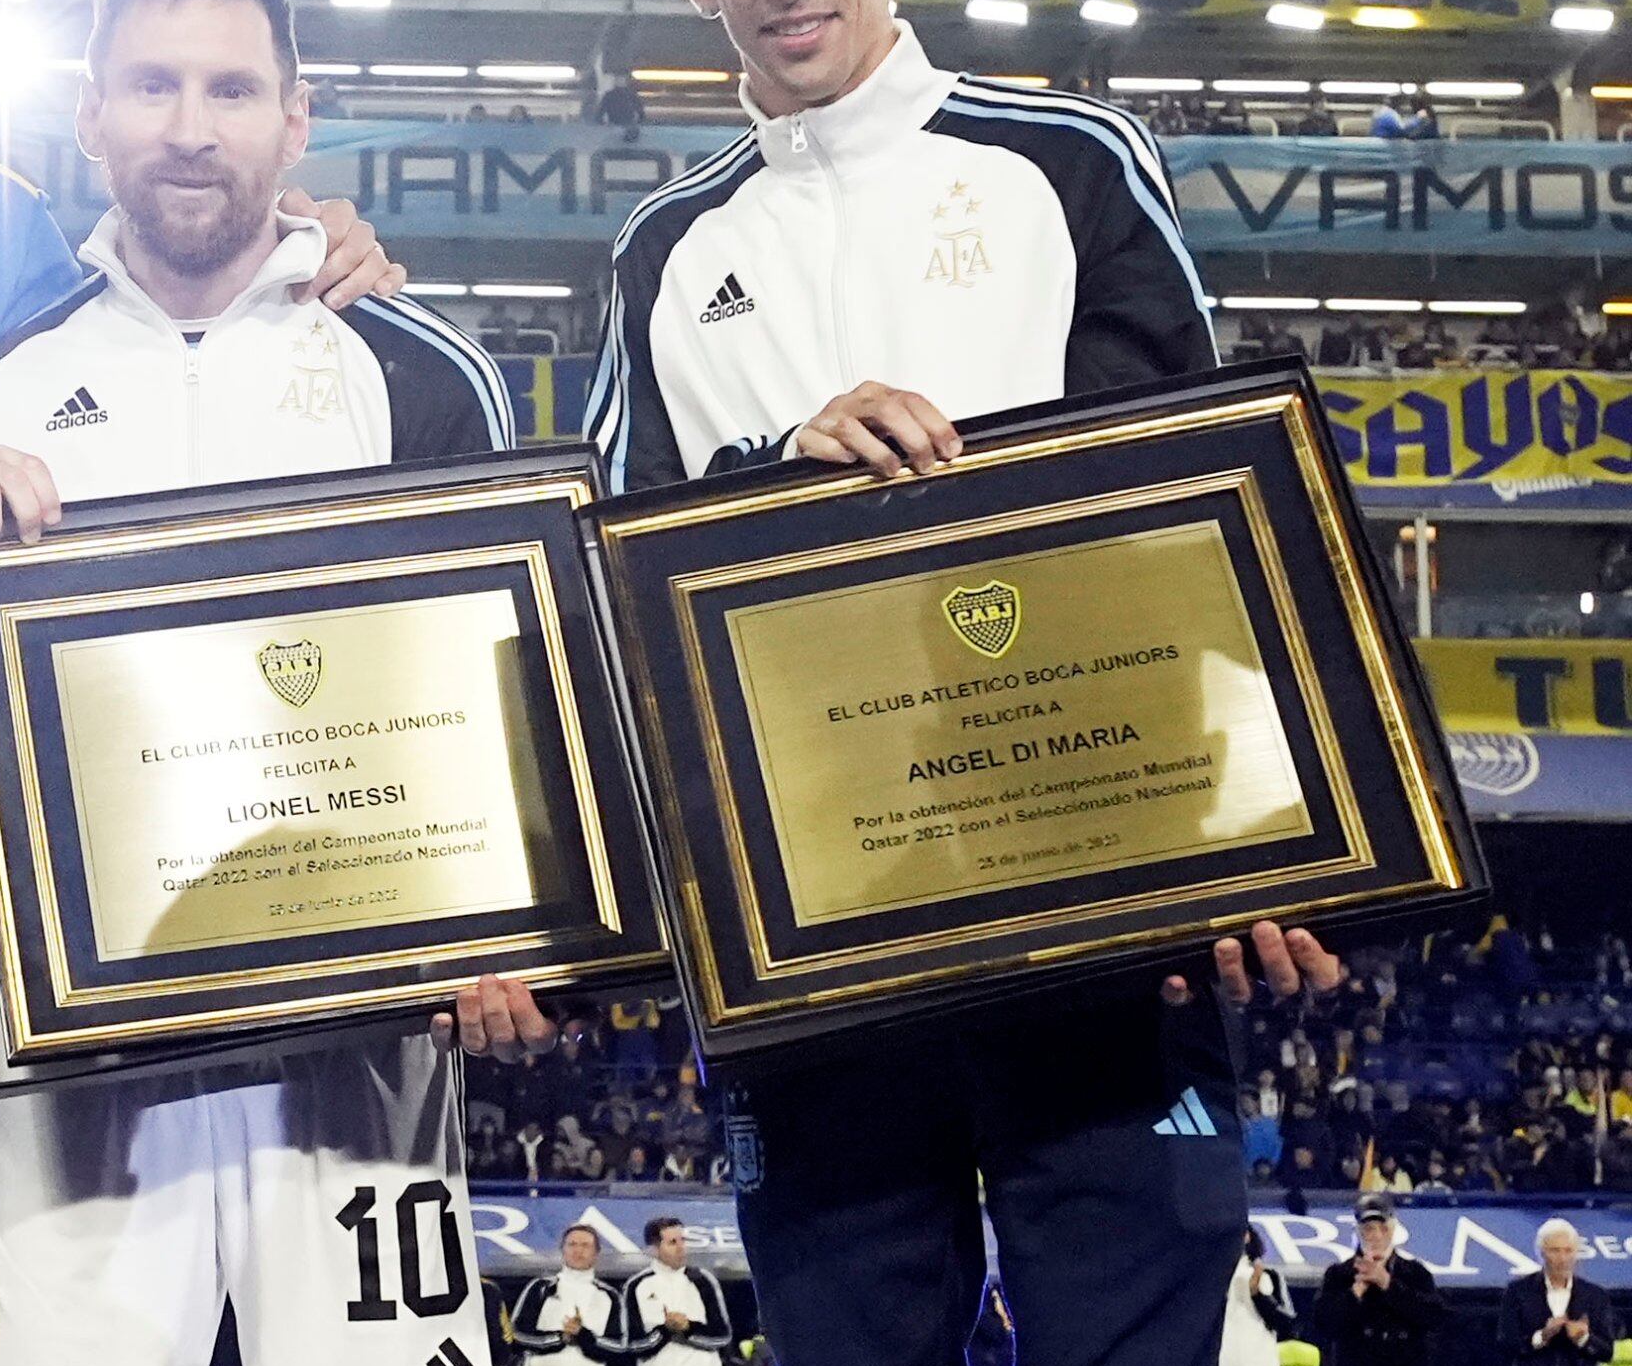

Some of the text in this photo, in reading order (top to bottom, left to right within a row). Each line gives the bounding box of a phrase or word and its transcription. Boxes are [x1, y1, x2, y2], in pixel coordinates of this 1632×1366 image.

[699, 296, 756, 325] adidas
[45, 407, 109, 433] adidas
[955, 599, 1014, 627] CABJ
[828, 645, 1181, 723] EL CLUB ATLETICO BOCA JUNIORS
[141, 748, 166, 765] EL
[227, 727, 321, 753] ATLETICO
[323, 720, 381, 741] BOCA
[383, 710, 468, 735] JUNIORS
[961, 699, 1064, 730] FELICITA A
[262, 755, 359, 780] FELICITA A
[908, 722, 1142, 784] ANGEL DI MARIA
[226, 783, 408, 825] LIONEL MESSI
[852, 753, 1213, 831] Por la obtención del Campeonato Mundial
[156, 817, 490, 871] Por la obtención del Campeonato Mundial
[861, 832, 910, 852] Qatar
[913, 823, 956, 843] 2022
[958, 819, 992, 835] con
[994, 814, 1012, 829] el
[1015, 792, 1133, 824] Seleccionado
[162, 876, 208, 894] Qatar
[306, 850, 413, 874] Seleccionado
[333, 1178, 469, 1322] 10
